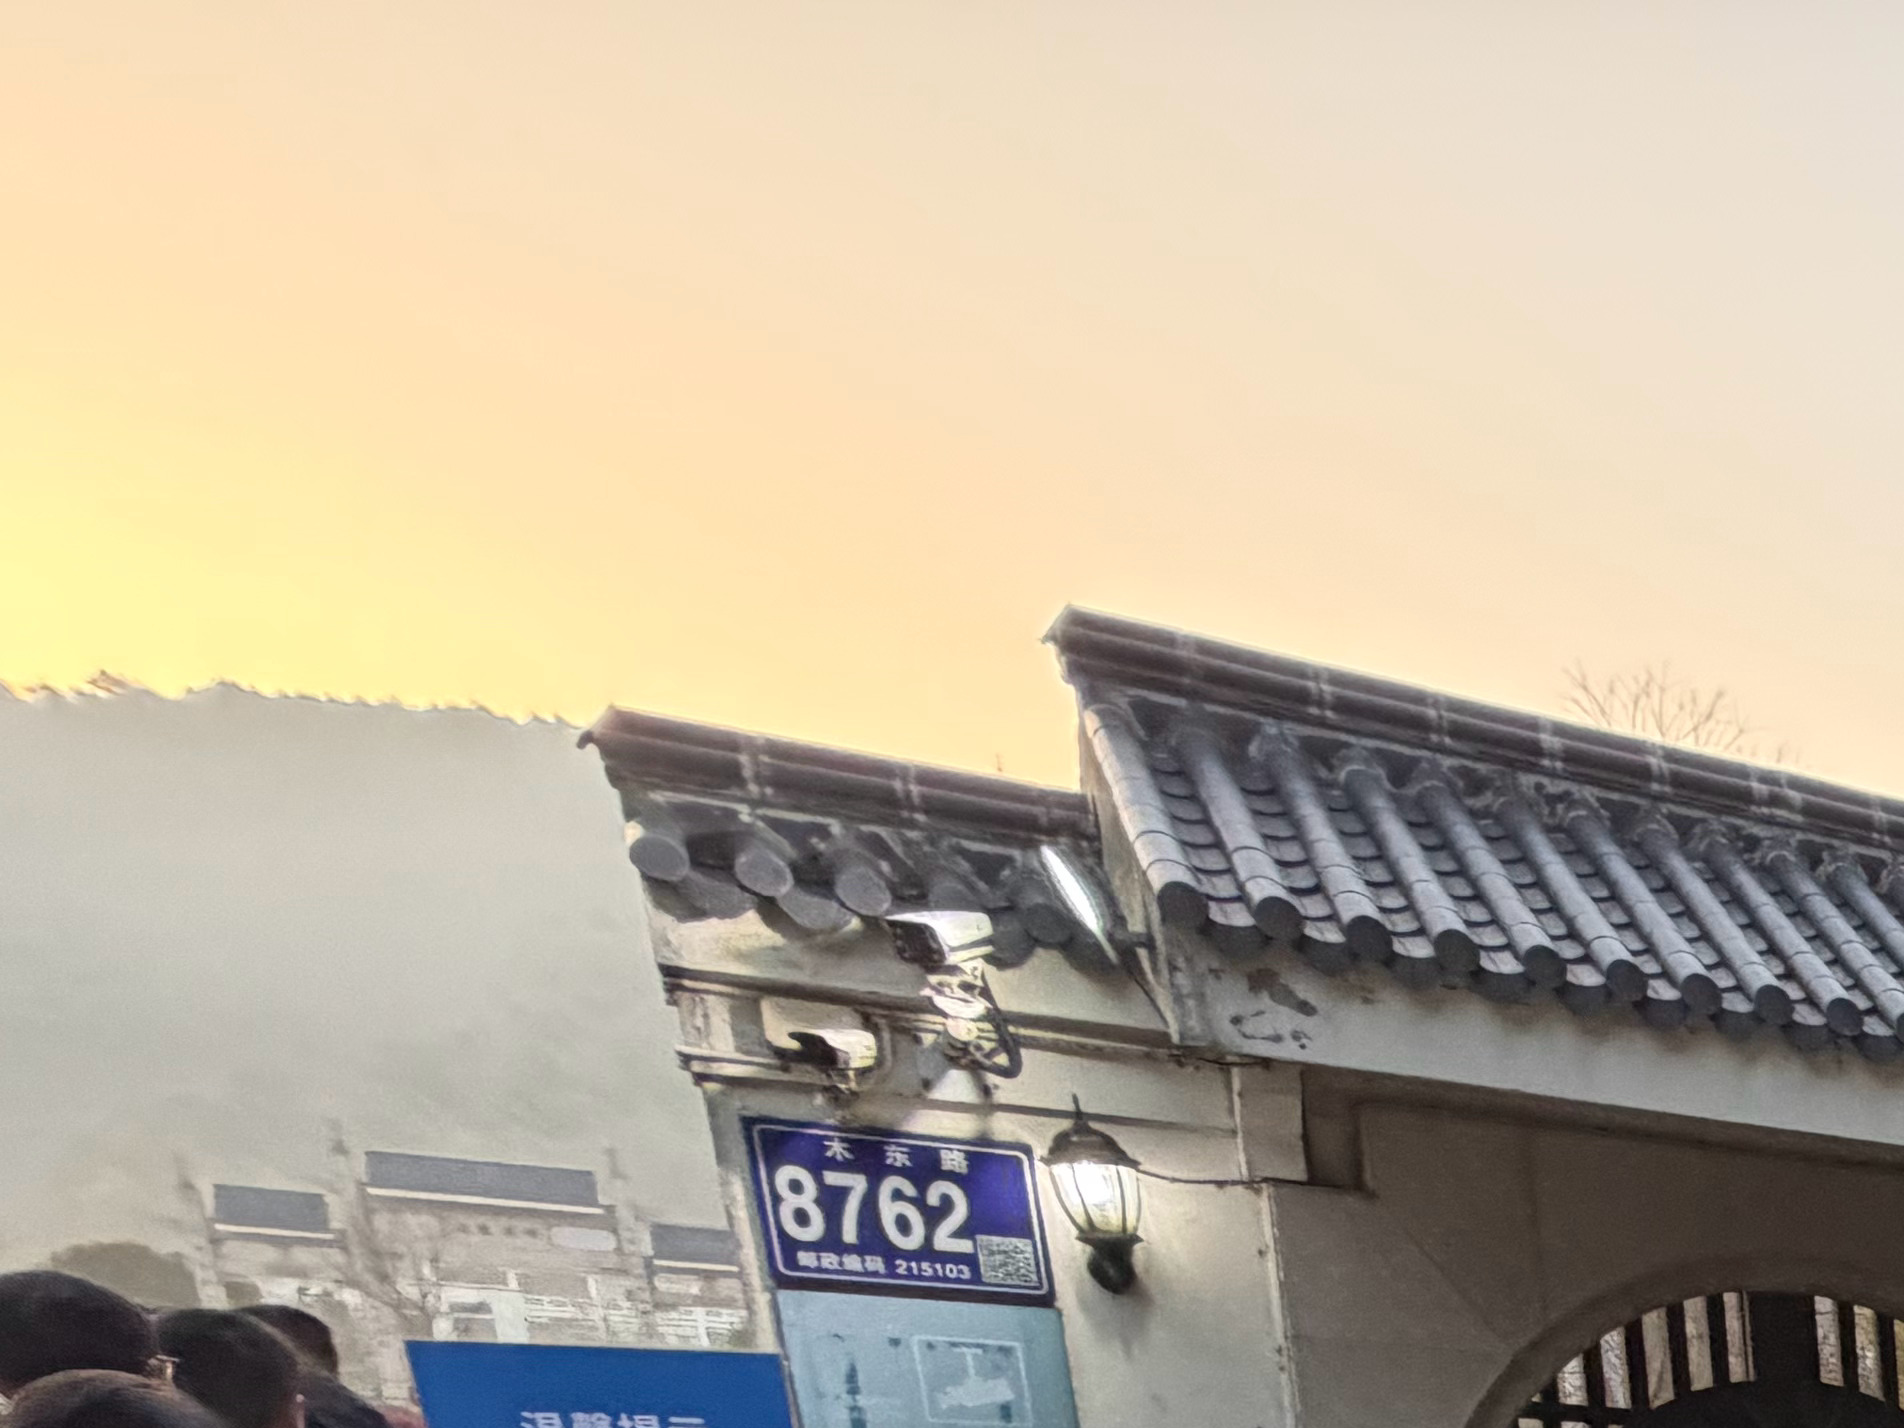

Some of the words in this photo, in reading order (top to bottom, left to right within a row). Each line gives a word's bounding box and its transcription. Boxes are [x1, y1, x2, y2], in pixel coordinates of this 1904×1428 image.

[823, 1137, 970, 1175] 木东路
[774, 1164, 975, 1254] 8762
[797, 1251, 886, 1275] 邮政编码
[895, 1259, 971, 1281] 215103
